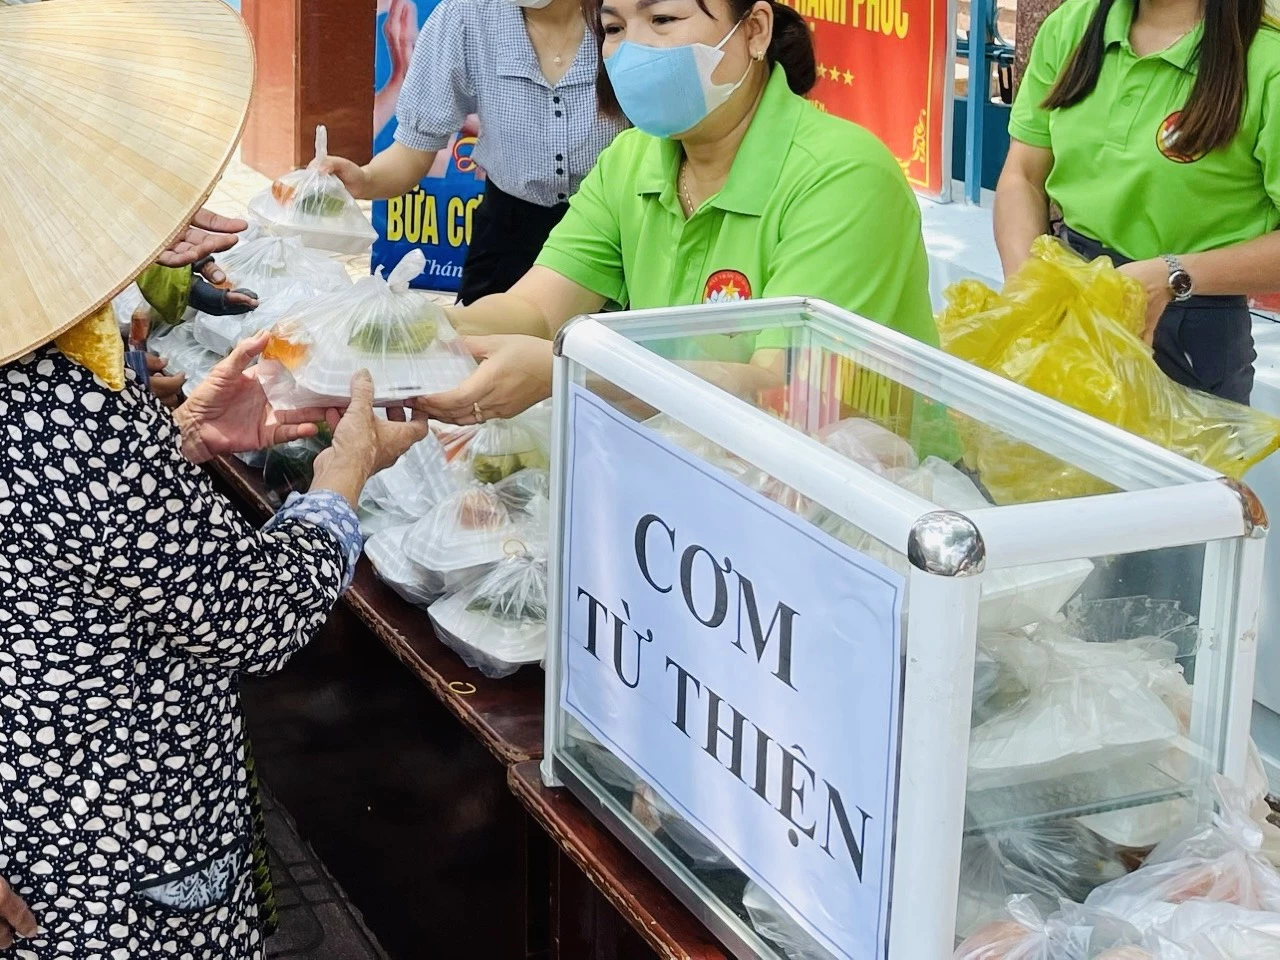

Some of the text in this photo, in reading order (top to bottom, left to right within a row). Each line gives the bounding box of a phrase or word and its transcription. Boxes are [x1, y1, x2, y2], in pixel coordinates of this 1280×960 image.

[421, 258, 463, 278] Thán
[447, 194, 484, 248] CƠ
[634, 513, 801, 692] CƠM
[577, 586, 873, 884] TỪ THIỆN
